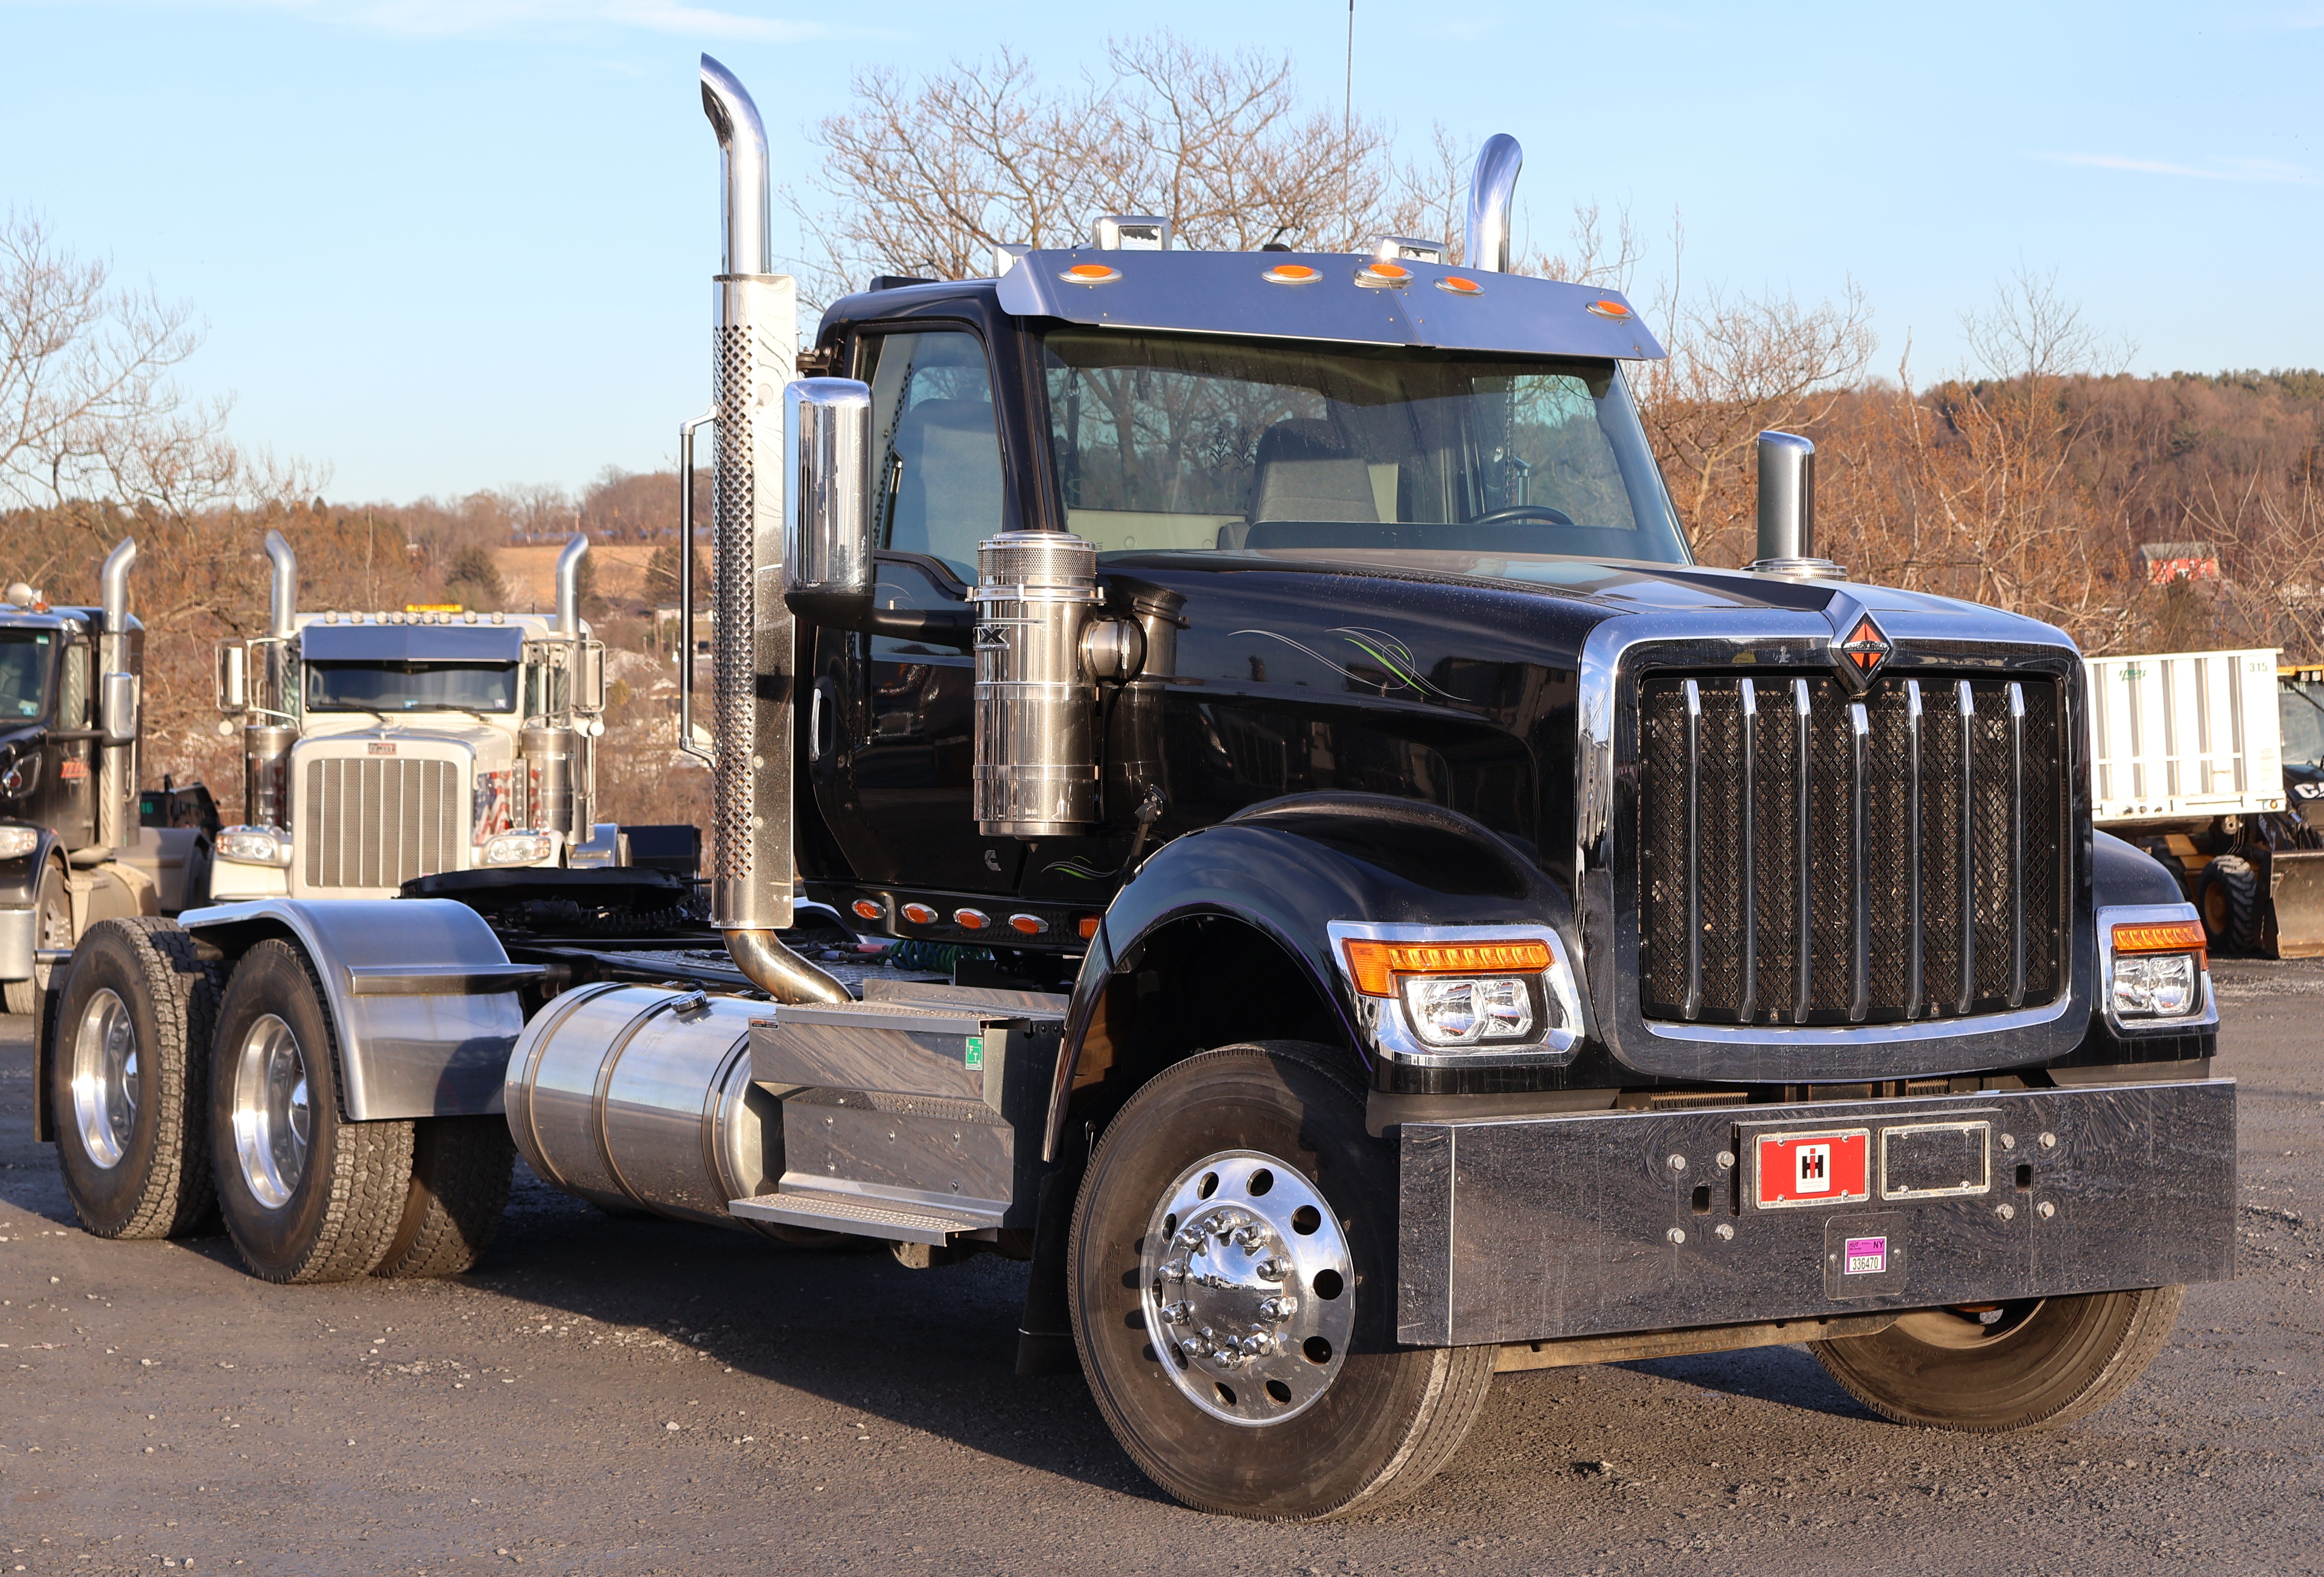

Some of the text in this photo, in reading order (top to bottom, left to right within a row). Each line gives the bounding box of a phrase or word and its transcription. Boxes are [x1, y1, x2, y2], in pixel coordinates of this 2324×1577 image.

[2249, 663, 2267, 672] 315
[1873, 1240, 1884, 1249] NY
[1853, 1257, 1878, 1270] 336470
